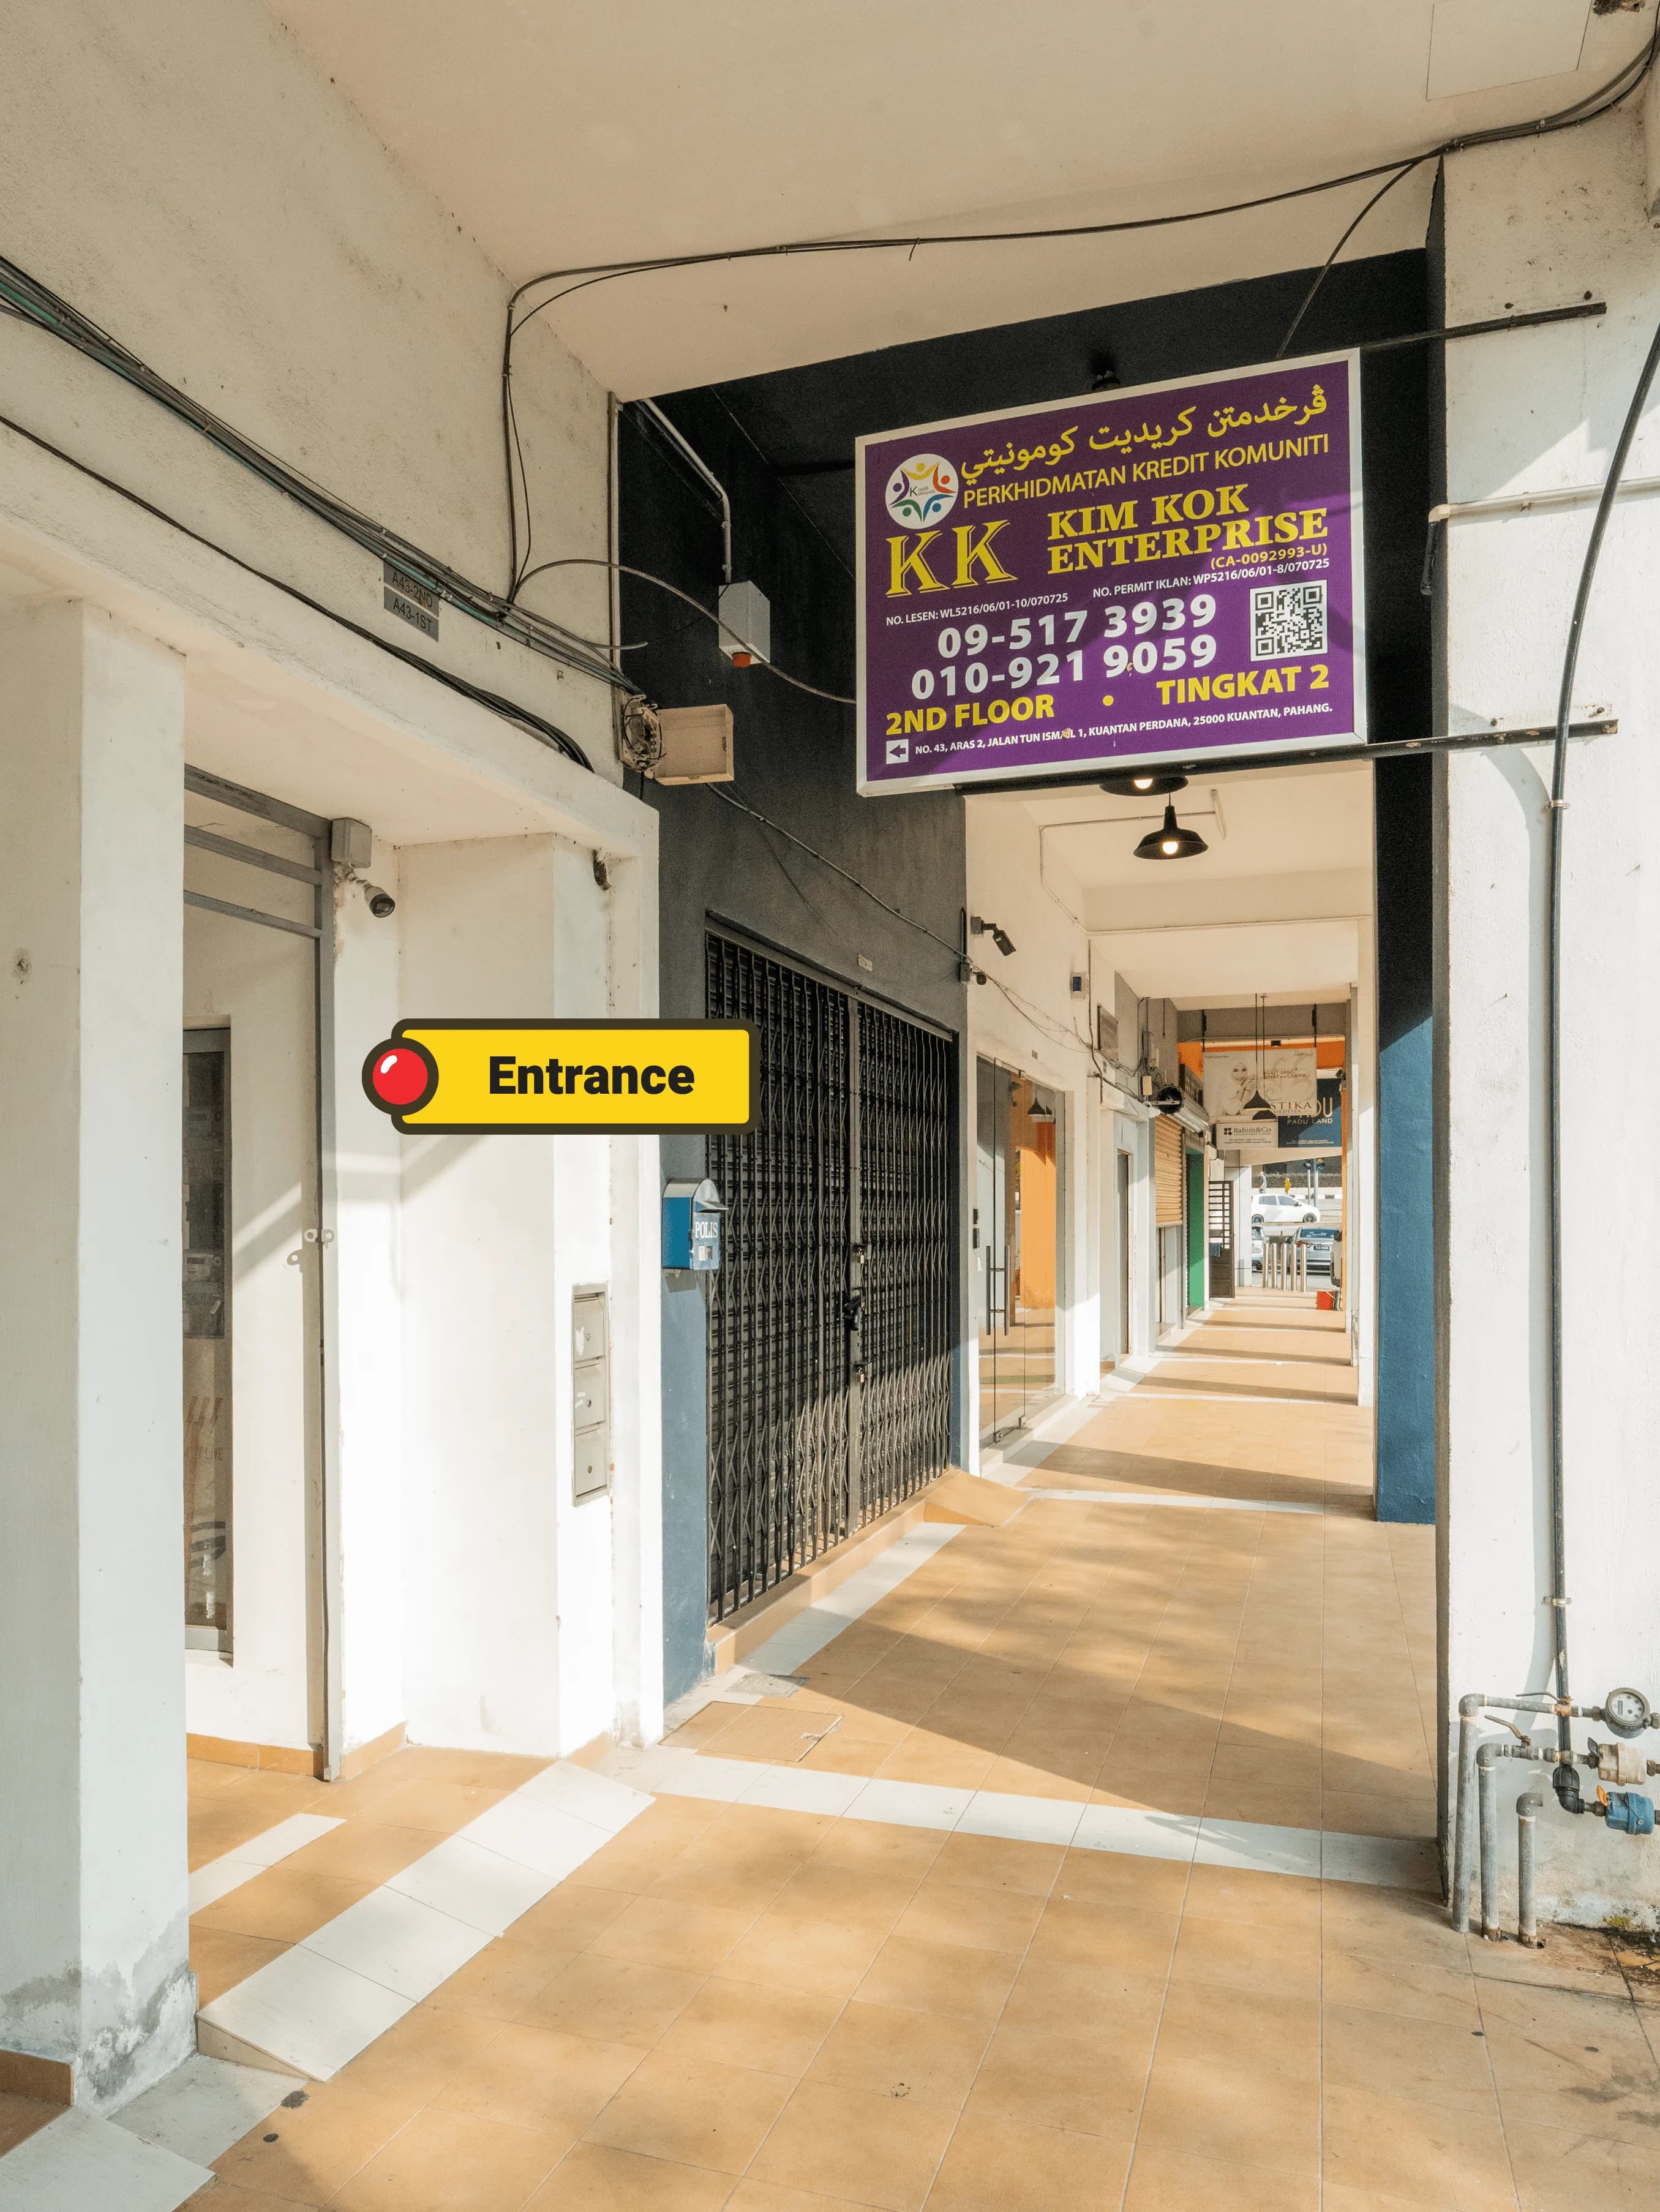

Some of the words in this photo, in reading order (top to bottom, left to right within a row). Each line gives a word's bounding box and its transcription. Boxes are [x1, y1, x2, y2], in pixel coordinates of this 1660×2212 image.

[964, 465, 1126, 509] PERKHIDMATAN
[1133, 451, 1210, 483] KREDIT
[1215, 433, 1329, 470] KOMUNITI
[1048, 500, 1138, 540] KIM
[1151, 484, 1249, 527] KOK
[1047, 507, 1328, 574] ENTERPRISE
[1211, 543, 1328, 570] (CA-0092993-U)
[392, 572, 432, 608] A43-2ND
[1093, 587, 1112, 598] NO.
[1114, 581, 1154, 595] PERMIT
[1155, 577, 1192, 590] IKLAN:
[1193, 558, 1330, 585] WP5216/06/01-8/070725
[393, 598, 432, 633] A43-1ST
[886, 615, 904, 626] NO.
[906, 611, 938, 623] LESEN:
[940, 592, 1068, 619] WL5216/06/01-10/070725
[938, 610, 1087, 658] 09-517
[1103, 594, 1216, 638] 3939
[912, 650, 1083, 699] 010-921
[1103, 634, 1217, 678] 9059
[886, 707, 947, 735] 2ND
[955, 694, 1054, 728] FLOOR
[1156, 666, 1302, 705] TINGKAT
[1310, 664, 1329, 690] 2
[915, 744, 933, 755] NO.
[934, 742, 948, 753] 43,
[950, 739, 975, 751] ARAS
[977, 738, 986, 749] 2,
[987, 733, 1019, 747] JALAN
[1020, 731, 1041, 742] TUN
[1042, 729, 1076, 741] ISML
[1078, 728, 1087, 739] 1,
[1089, 723, 1138, 736] KUANTAN
[1139, 717, 1192, 731] PERDANA,
[1193, 713, 1225, 726] 25000
[1226, 707, 1282, 723] KUANTAN,
[1283, 702, 1334, 717] PAHANG.
[1271, 1101, 1312, 1110] STIKA
[694, 1221, 718, 1239] POLIS
